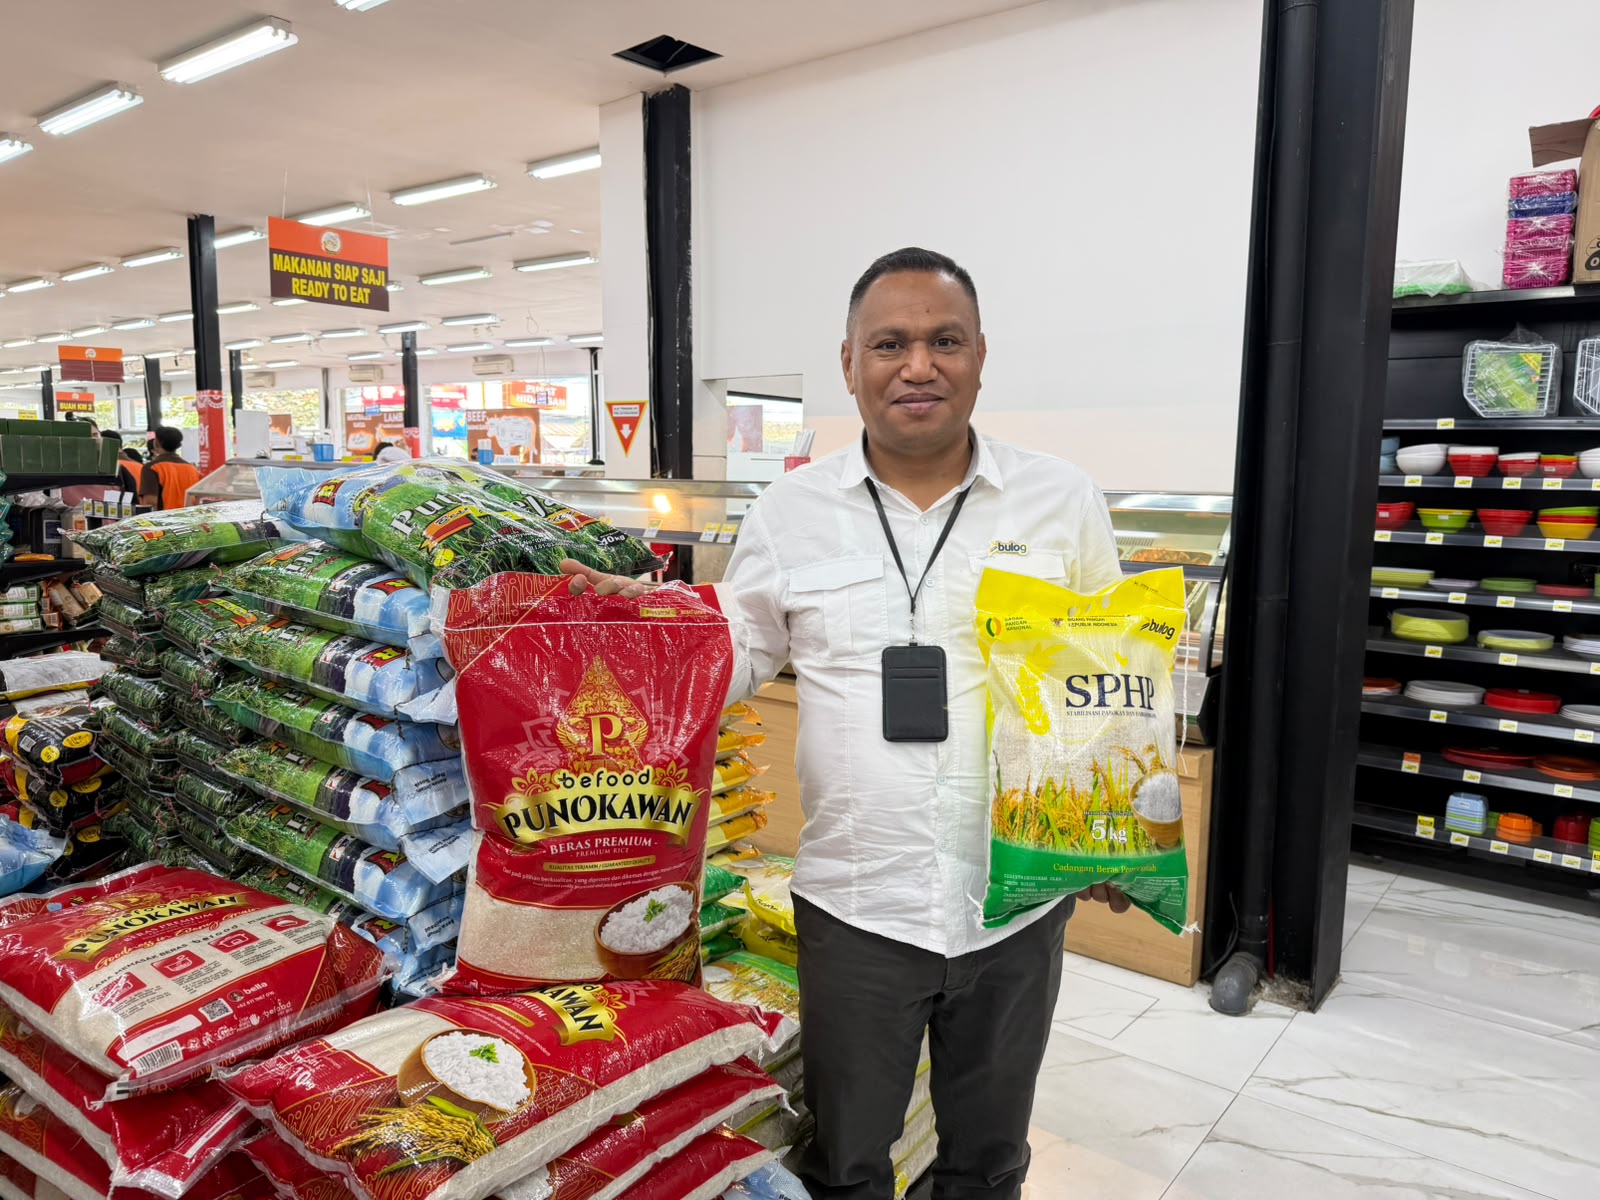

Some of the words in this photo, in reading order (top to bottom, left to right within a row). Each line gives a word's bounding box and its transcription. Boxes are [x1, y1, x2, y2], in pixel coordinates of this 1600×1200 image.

[273, 253, 331, 278] MAKANAN
[334, 263, 359, 282] SIAP
[362, 268, 385, 287] SAJI
[292, 277, 330, 298] READY
[332, 283, 348, 301] TO
[350, 286, 371, 304] EAT
[467, 411, 487, 422] BEEF
[998, 542, 1027, 554] bulog
[1149, 618, 1176, 640] bulog
[1065, 674, 1154, 710] SPHP
[559, 769, 650, 789] befood
[502, 793, 694, 839] PUNOKAWAN
[550, 839, 591, 855] BERAS
[594, 836, 652, 848] PREMIUM
[576, 848, 611, 857] PREMIUM
[1053, 863, 1094, 873] Cadangan
[1097, 865, 1119, 873] Beras
[69, 896, 237, 954] PUNOKAWAN
[123, 927, 158, 941] BERAS
[160, 912, 213, 927] PREMIUM
[88, 975, 114, 991] CARA
[115, 954, 158, 975] MEMASAK
[159, 943, 189, 957] BERAS
[191, 924, 238, 944] befood
[243, 982, 268, 994] bella
